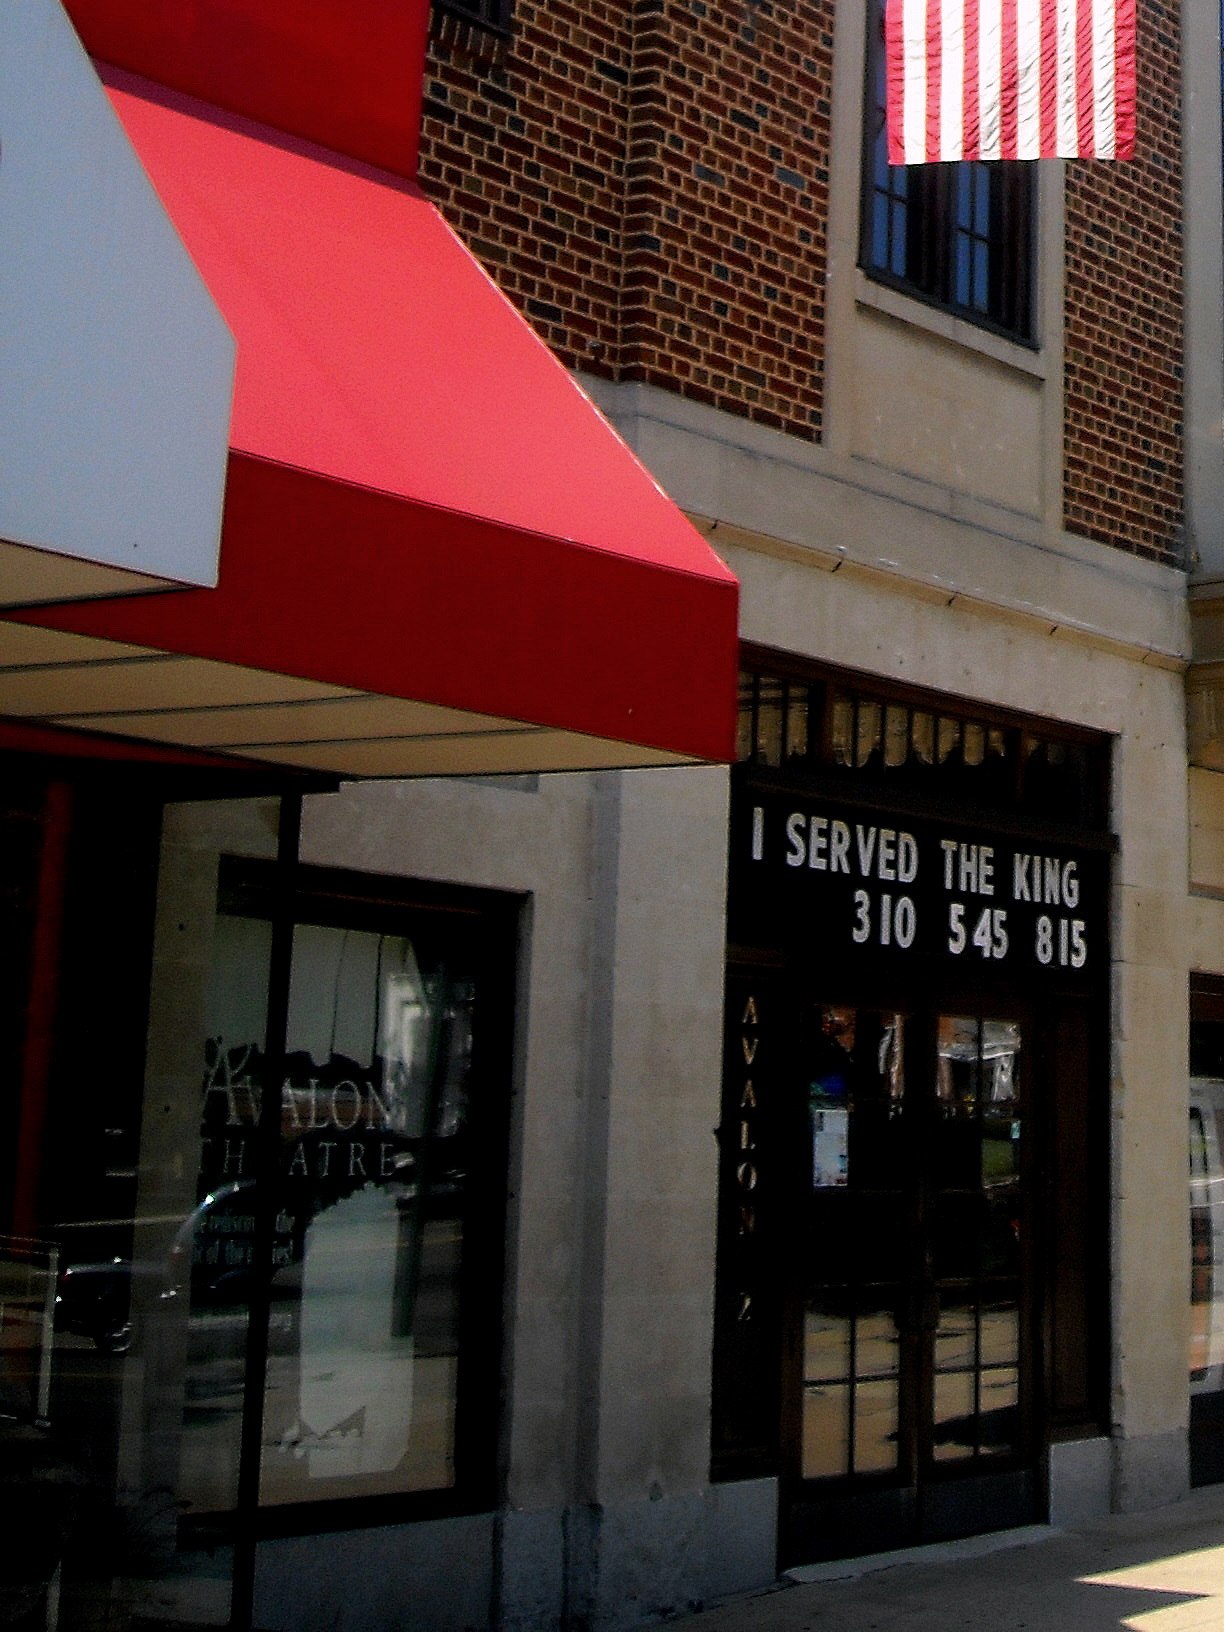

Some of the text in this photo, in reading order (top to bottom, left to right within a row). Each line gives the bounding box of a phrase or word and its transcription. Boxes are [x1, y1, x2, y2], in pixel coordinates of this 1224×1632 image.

[752, 806, 1082, 911] I SERVED THE KING
[201, 1134, 397, 1178] THATRE
[735, 995, 761, 1236] AVALON
